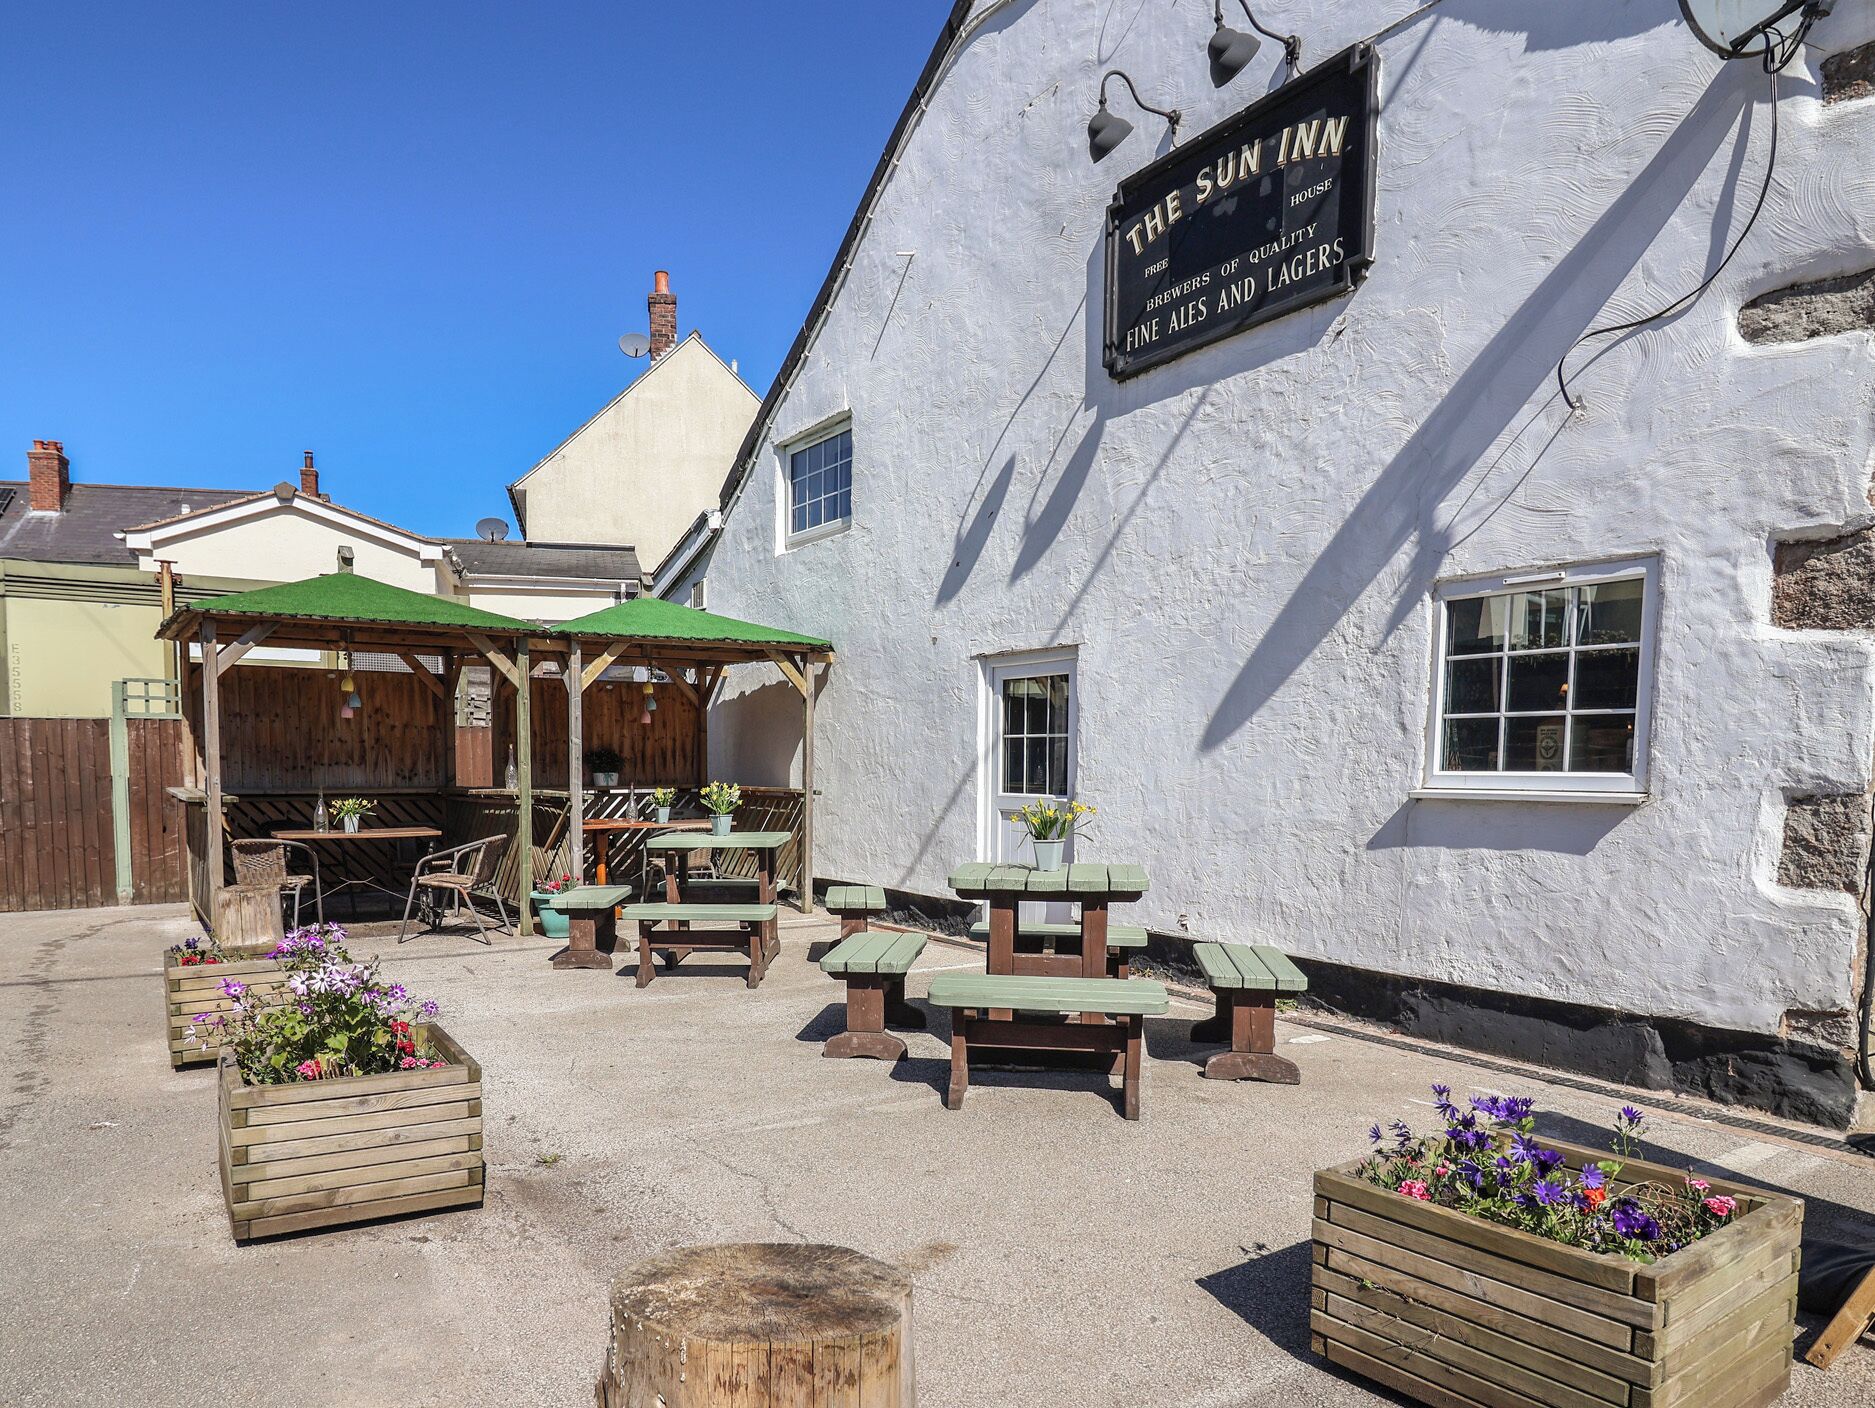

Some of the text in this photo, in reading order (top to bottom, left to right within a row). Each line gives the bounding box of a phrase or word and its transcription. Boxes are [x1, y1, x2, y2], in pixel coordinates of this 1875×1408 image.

[1126, 115, 1350, 256] THE SUN INN
[1144, 178, 1333, 278] FREE HOUSE
[1126, 237, 1344, 352] FINE ALES AND LAGERS
[1146, 222, 1317, 312] BREWERS OF QUALITY
